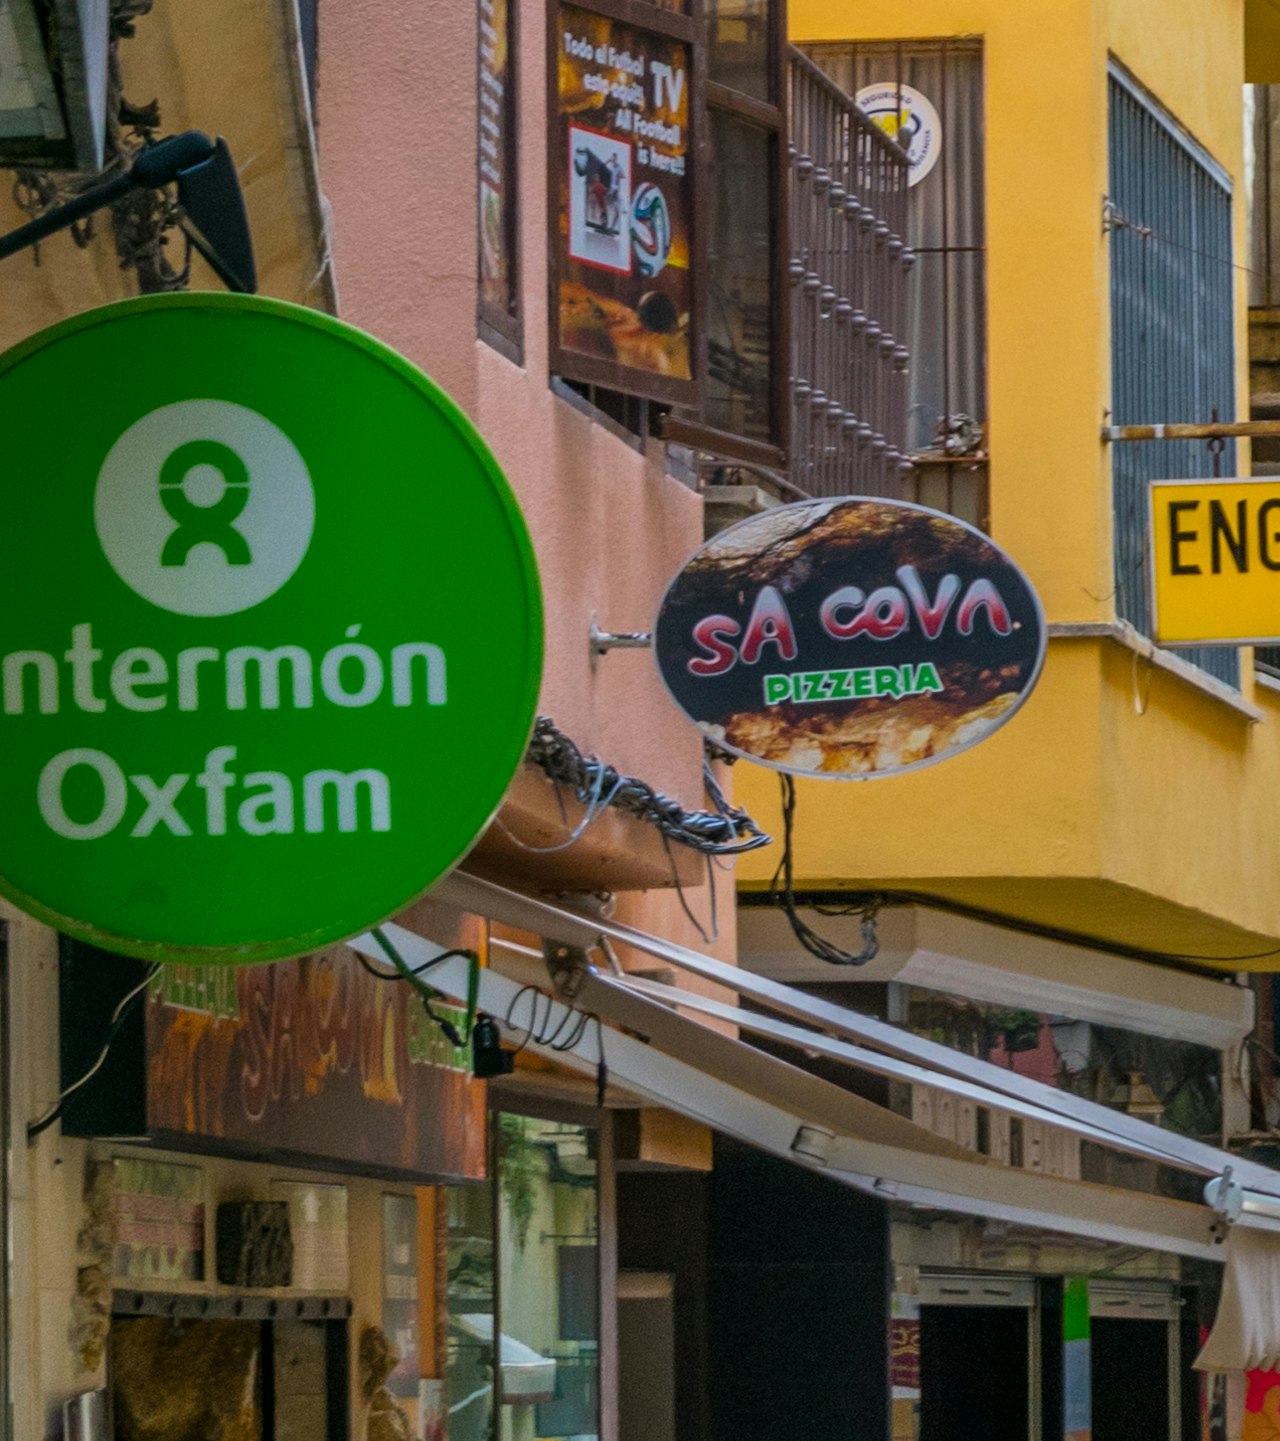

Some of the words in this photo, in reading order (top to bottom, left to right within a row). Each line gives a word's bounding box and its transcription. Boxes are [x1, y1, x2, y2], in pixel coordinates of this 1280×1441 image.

[650, 60, 684, 113] TV
[2, 623, 448, 716] ntermón
[686, 584, 798, 677] SA
[763, 662, 944, 706] PIZZERIA
[38, 746, 392, 841] Oxfam
